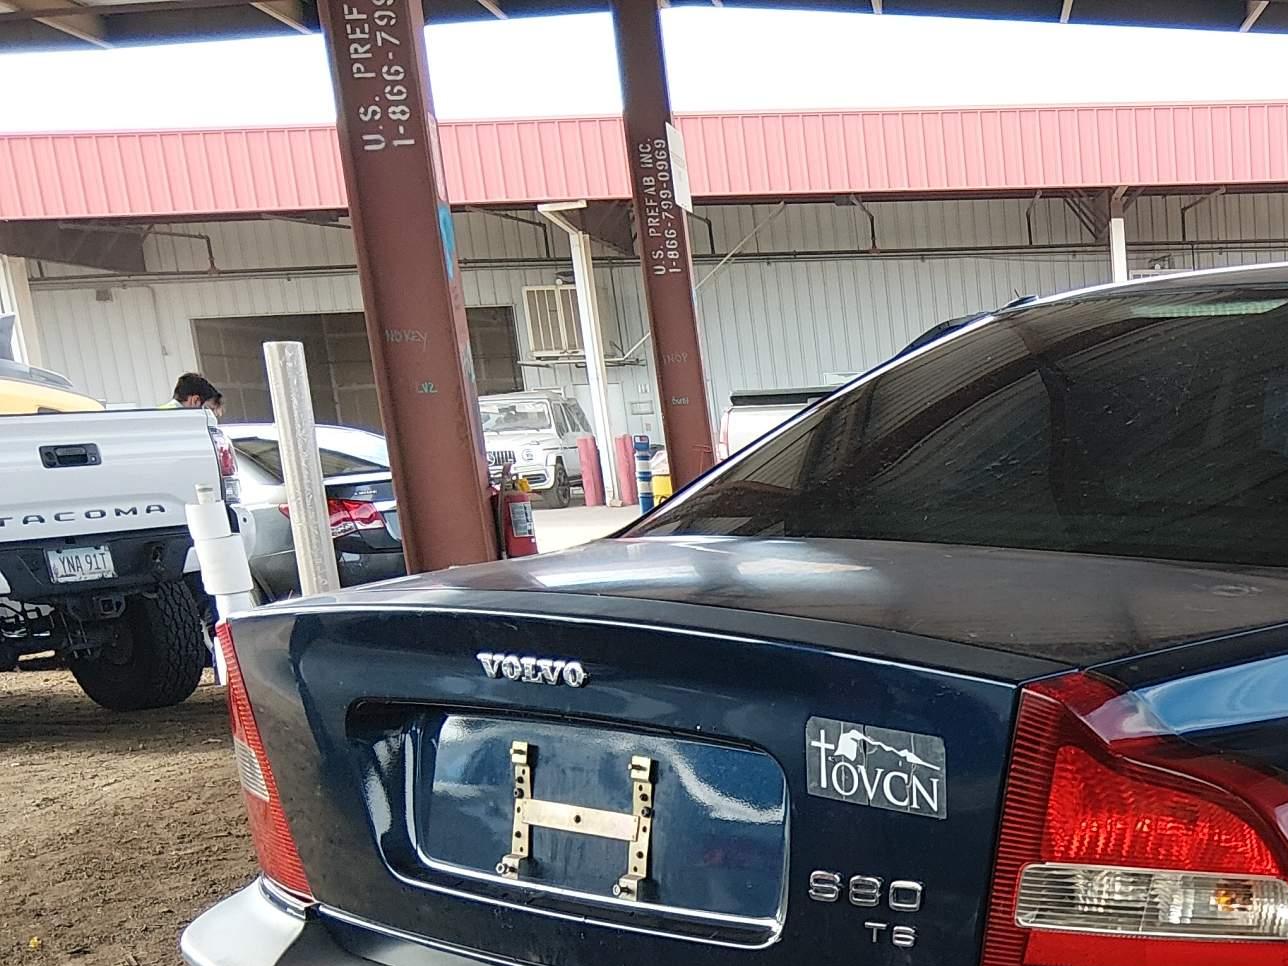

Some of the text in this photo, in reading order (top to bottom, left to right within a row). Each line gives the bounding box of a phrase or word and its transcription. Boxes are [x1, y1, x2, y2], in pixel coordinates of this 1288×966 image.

[358, 97, 386, 151] U.S.
[638, 137, 667, 275] U.S. PREFAB INC.
[653, 139, 682, 273] 1-866-799-0969
[0, 504, 166, 528] TACOMA
[58, 553, 108, 574] YNA 91T
[477, 652, 587, 688] VOLVO
[808, 869, 923, 913] S80
[864, 920, 919, 948] T6
